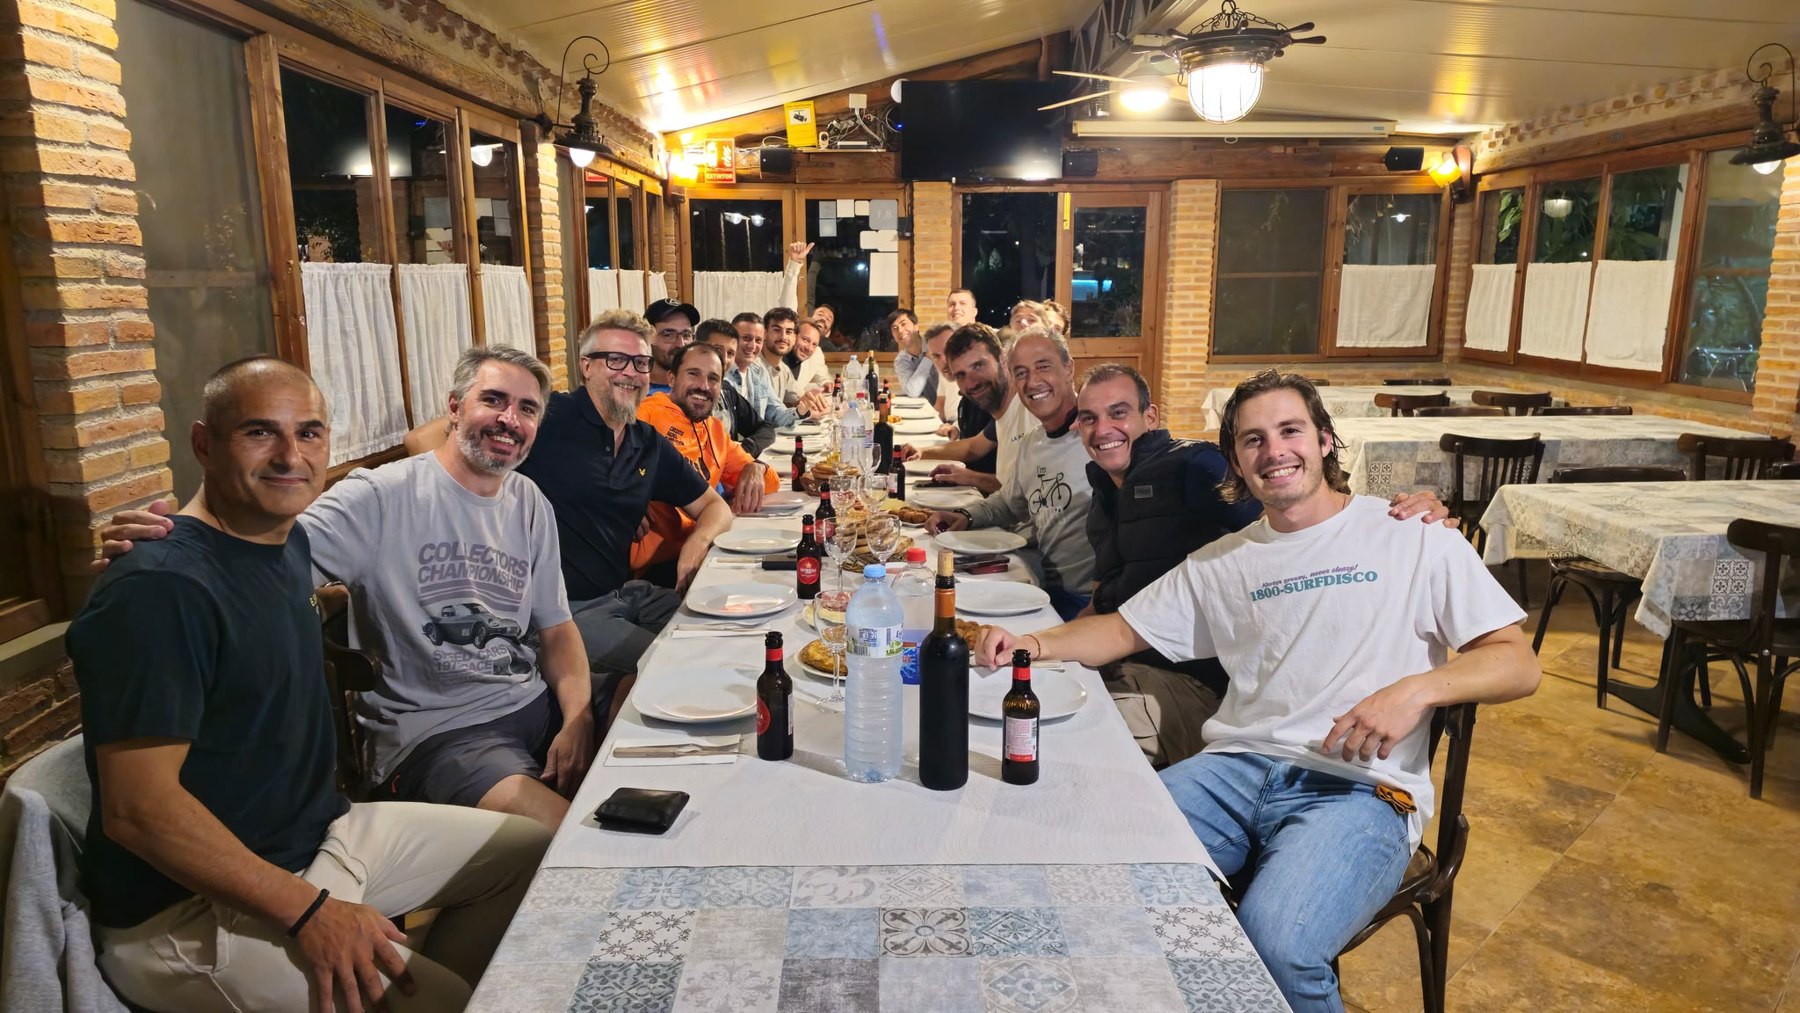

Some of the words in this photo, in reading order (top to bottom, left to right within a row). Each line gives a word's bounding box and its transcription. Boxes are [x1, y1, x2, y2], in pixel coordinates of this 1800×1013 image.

[418, 541, 529, 577] COLLECTORS
[418, 562, 526, 592] CHAMPIONSHIP
[1250, 570, 1378, 602] 1800-SURFDISCO
[1262, 579, 1282, 588] Always
[1310, 568, 1330, 577] never
[477, 644, 507, 660] CARS
